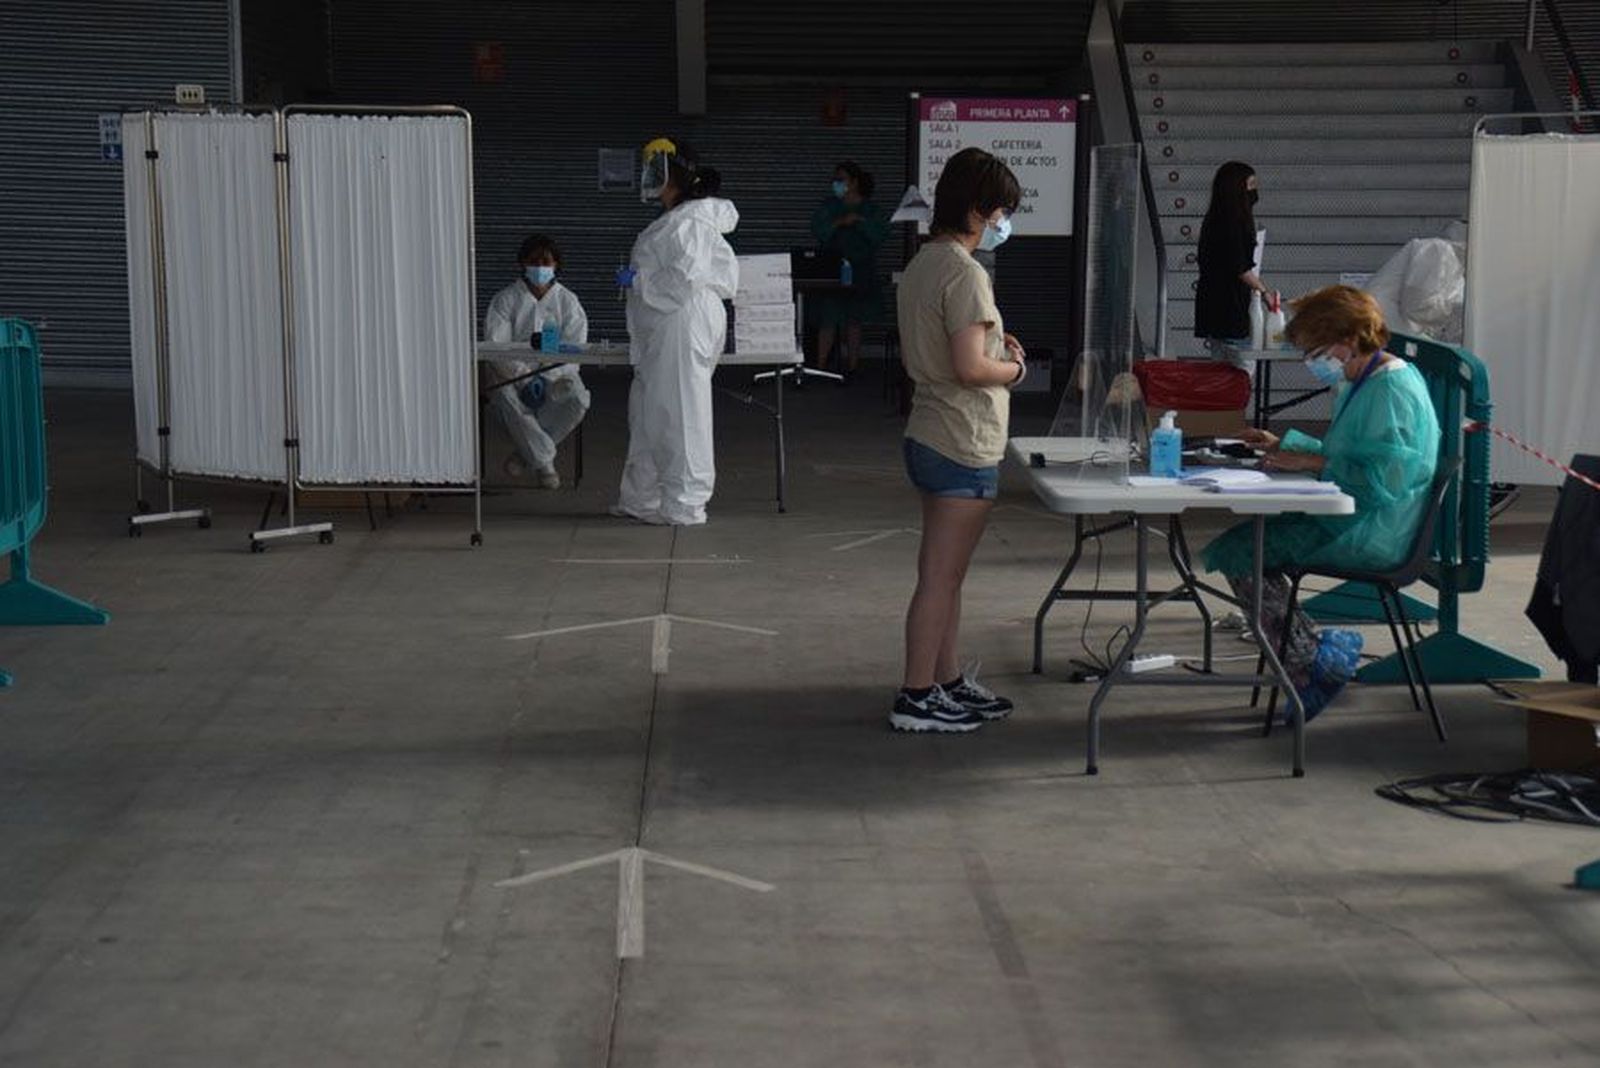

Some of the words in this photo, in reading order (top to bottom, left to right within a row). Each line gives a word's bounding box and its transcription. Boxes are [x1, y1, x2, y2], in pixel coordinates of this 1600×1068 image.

[969, 107, 1012, 119] PRIMERA
[1014, 108, 1050, 119] PLANTA
[928, 123, 954, 133] SALA
[928, 139, 953, 149] SALA
[1010, 155, 1023, 166] DE
[1025, 155, 1057, 167] ACTOS
